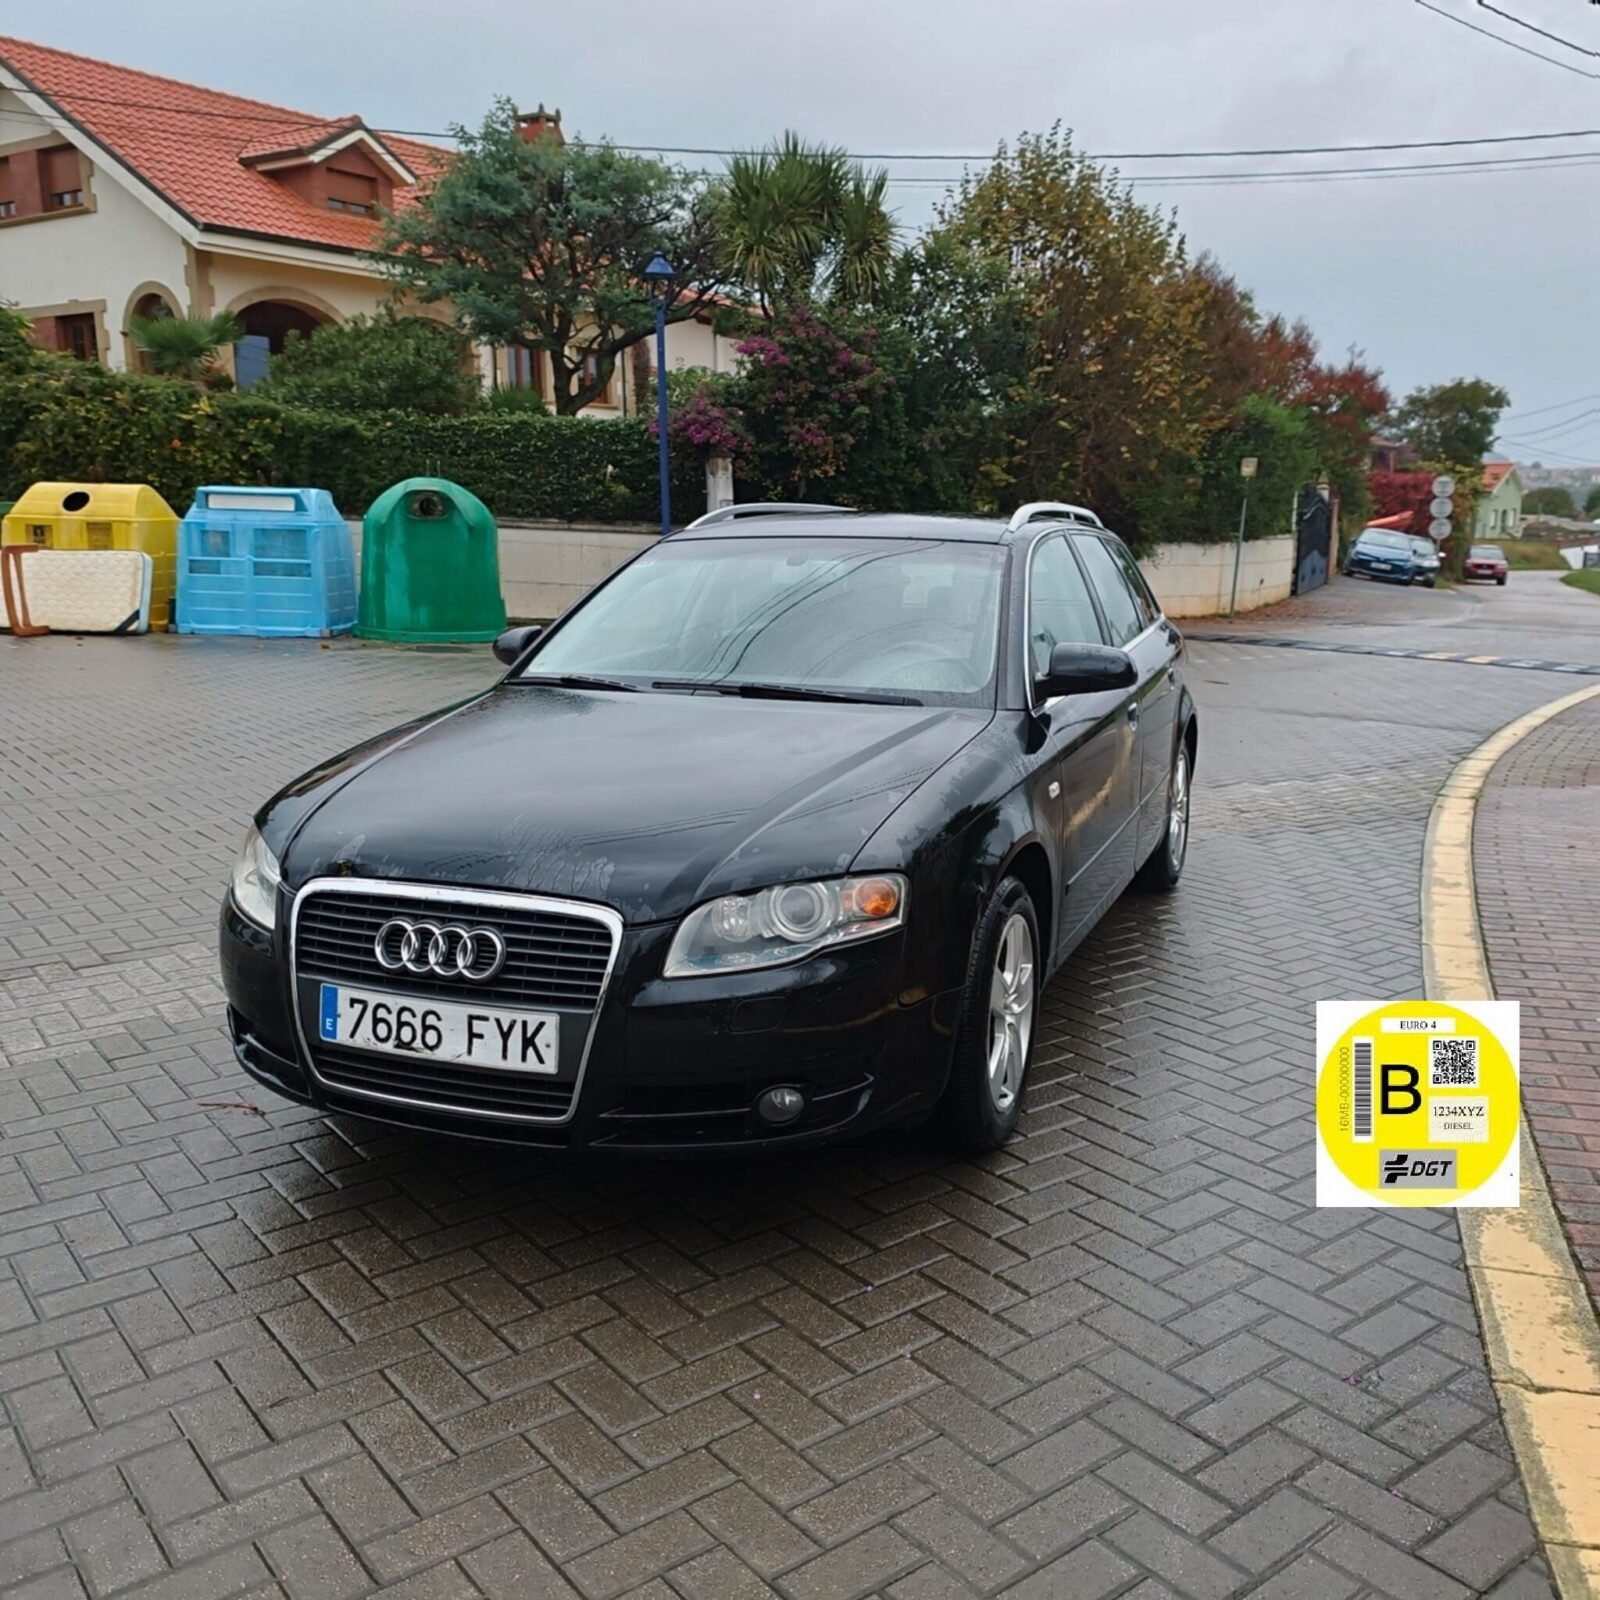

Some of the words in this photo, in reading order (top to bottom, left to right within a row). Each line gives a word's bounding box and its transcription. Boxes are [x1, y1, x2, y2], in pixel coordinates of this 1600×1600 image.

[325, 1018, 333, 1031] E
[349, 997, 443, 1052] 7666
[466, 1013, 546, 1065] FYK
